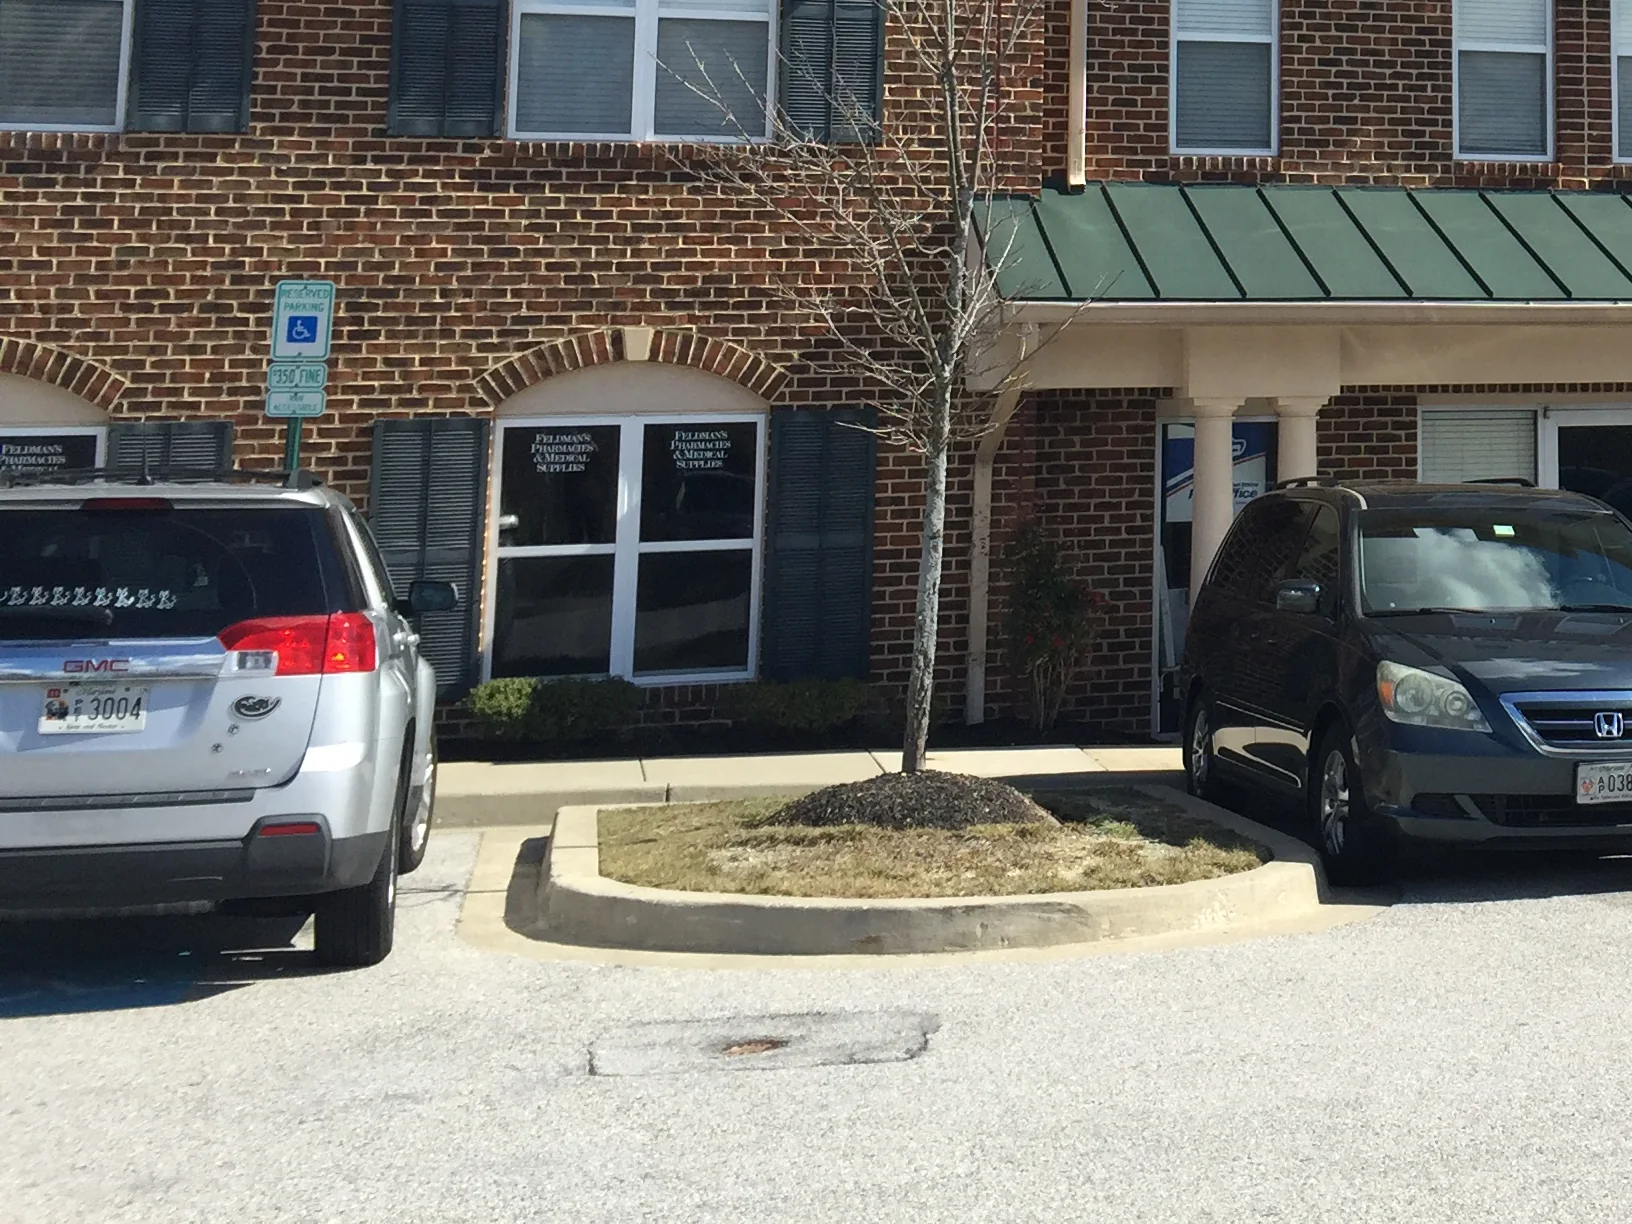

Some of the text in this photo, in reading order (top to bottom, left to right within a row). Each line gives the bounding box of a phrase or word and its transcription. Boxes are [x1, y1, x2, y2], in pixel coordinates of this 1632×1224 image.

[280, 289, 329, 299] RESERVED
[283, 302, 324, 312] PARKING
[299, 369, 322, 384] FINE
[535, 433, 591, 443] FELDMAN'S
[675, 430, 728, 440] FELDMAN'S
[530, 444, 594, 453] PHARMACIES
[670, 440, 731, 450] PHARMACIES
[536, 463, 586, 472] SUPPLIES
[676, 459, 724, 468] SUPPLIES
[63, 659, 129, 673] GMC
